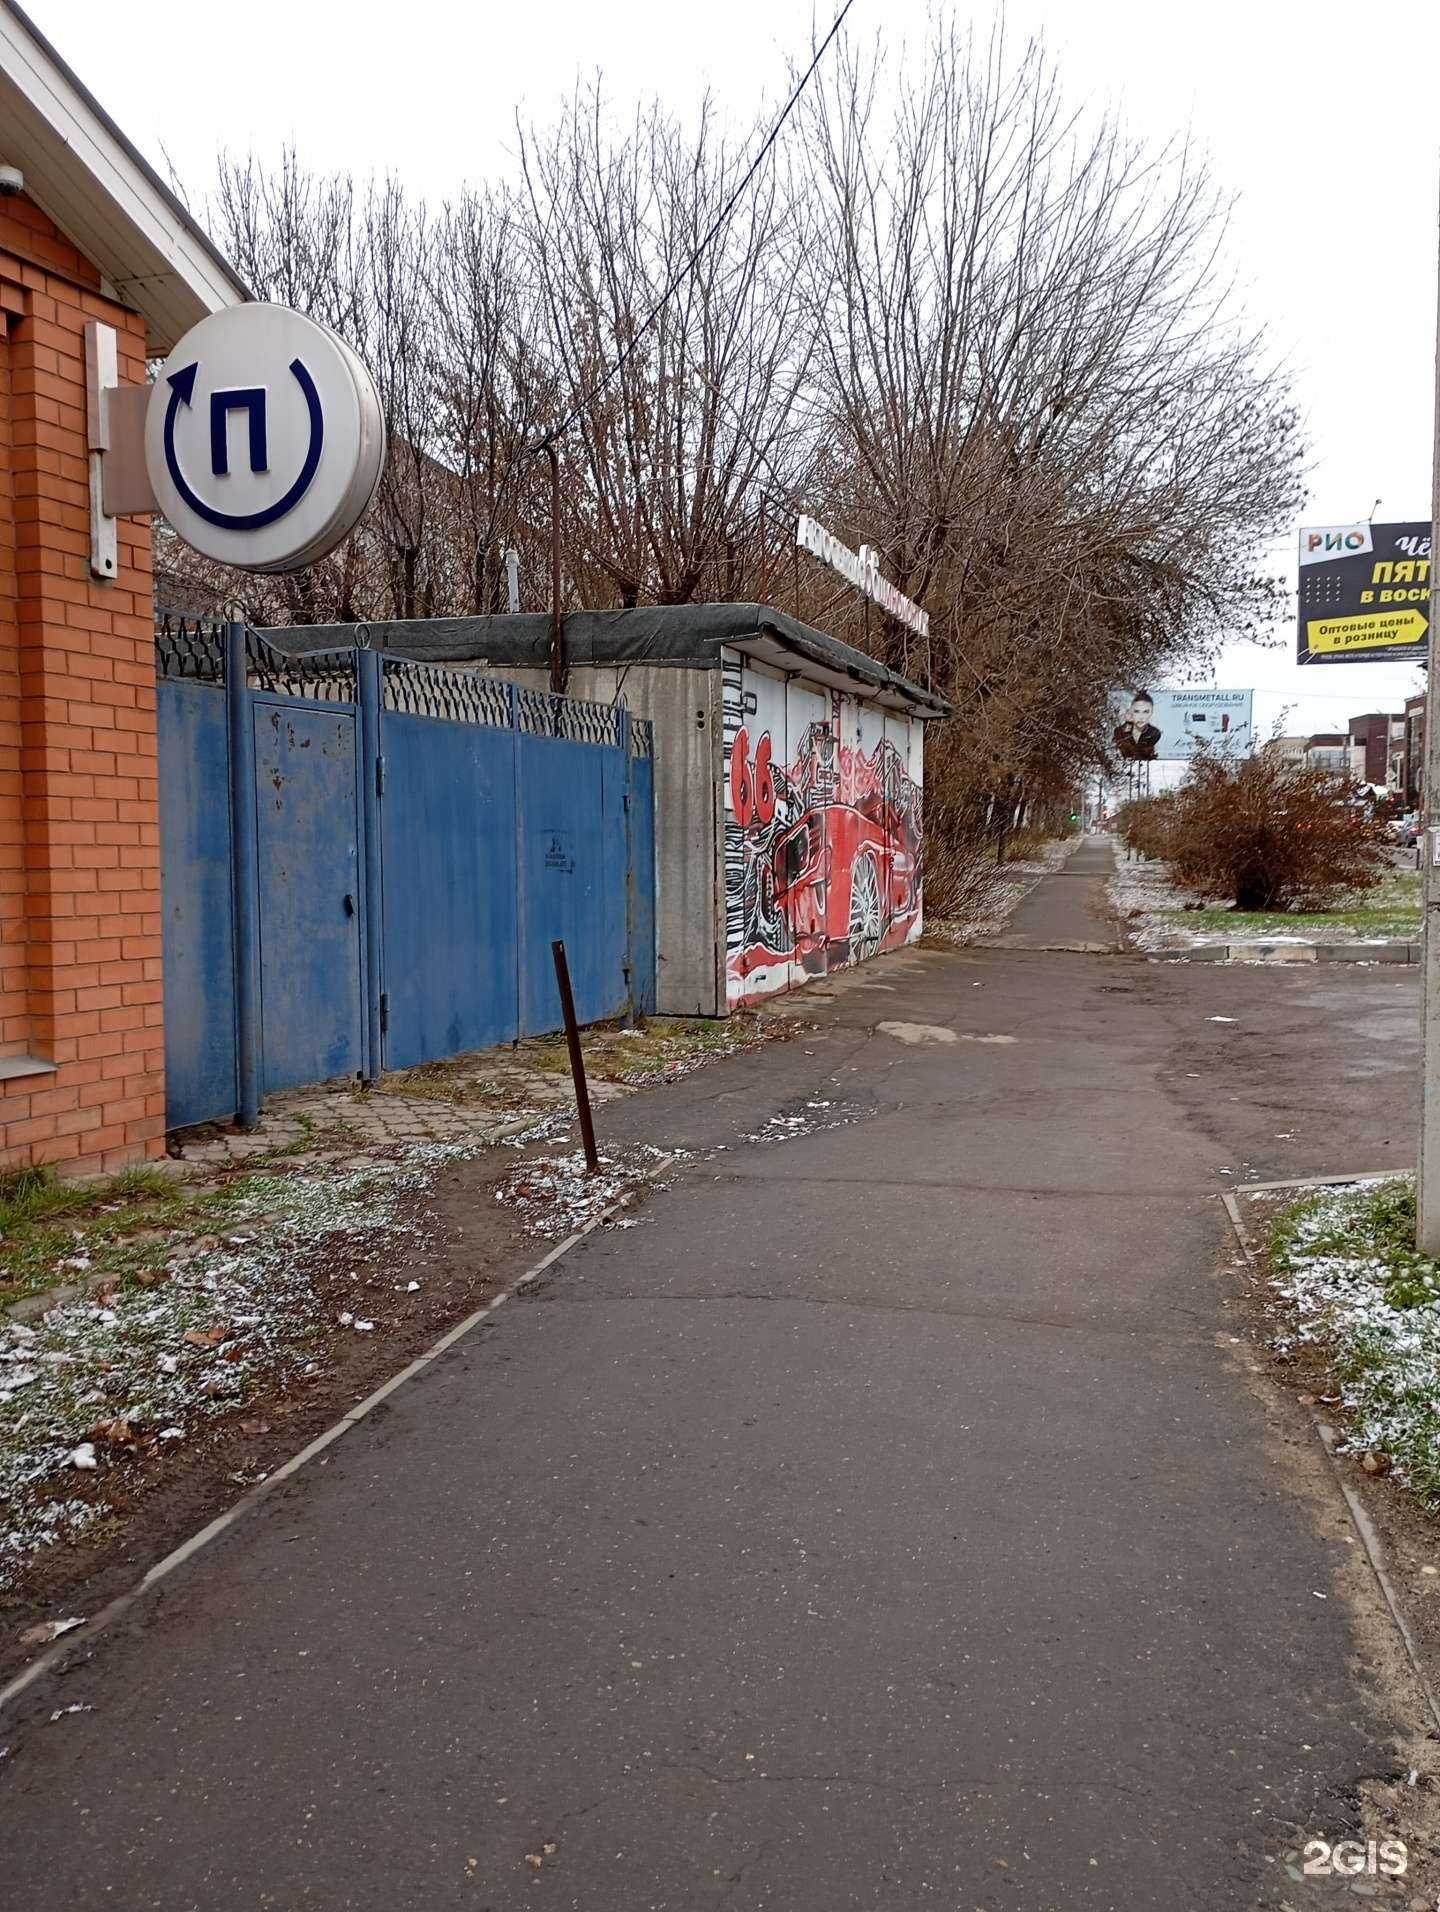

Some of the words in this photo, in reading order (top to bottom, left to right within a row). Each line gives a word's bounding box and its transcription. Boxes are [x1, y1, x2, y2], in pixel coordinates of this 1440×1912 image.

[210, 387, 268, 475] П
[1308, 531, 1365, 553] РИО
[1394, 535, 1432, 559] Чё
[1319, 621, 1375, 636] Оптовые
[1379, 615, 1415, 629] цены
[1333, 637, 1341, 645] в
[1344, 629, 1399, 646] розницу
